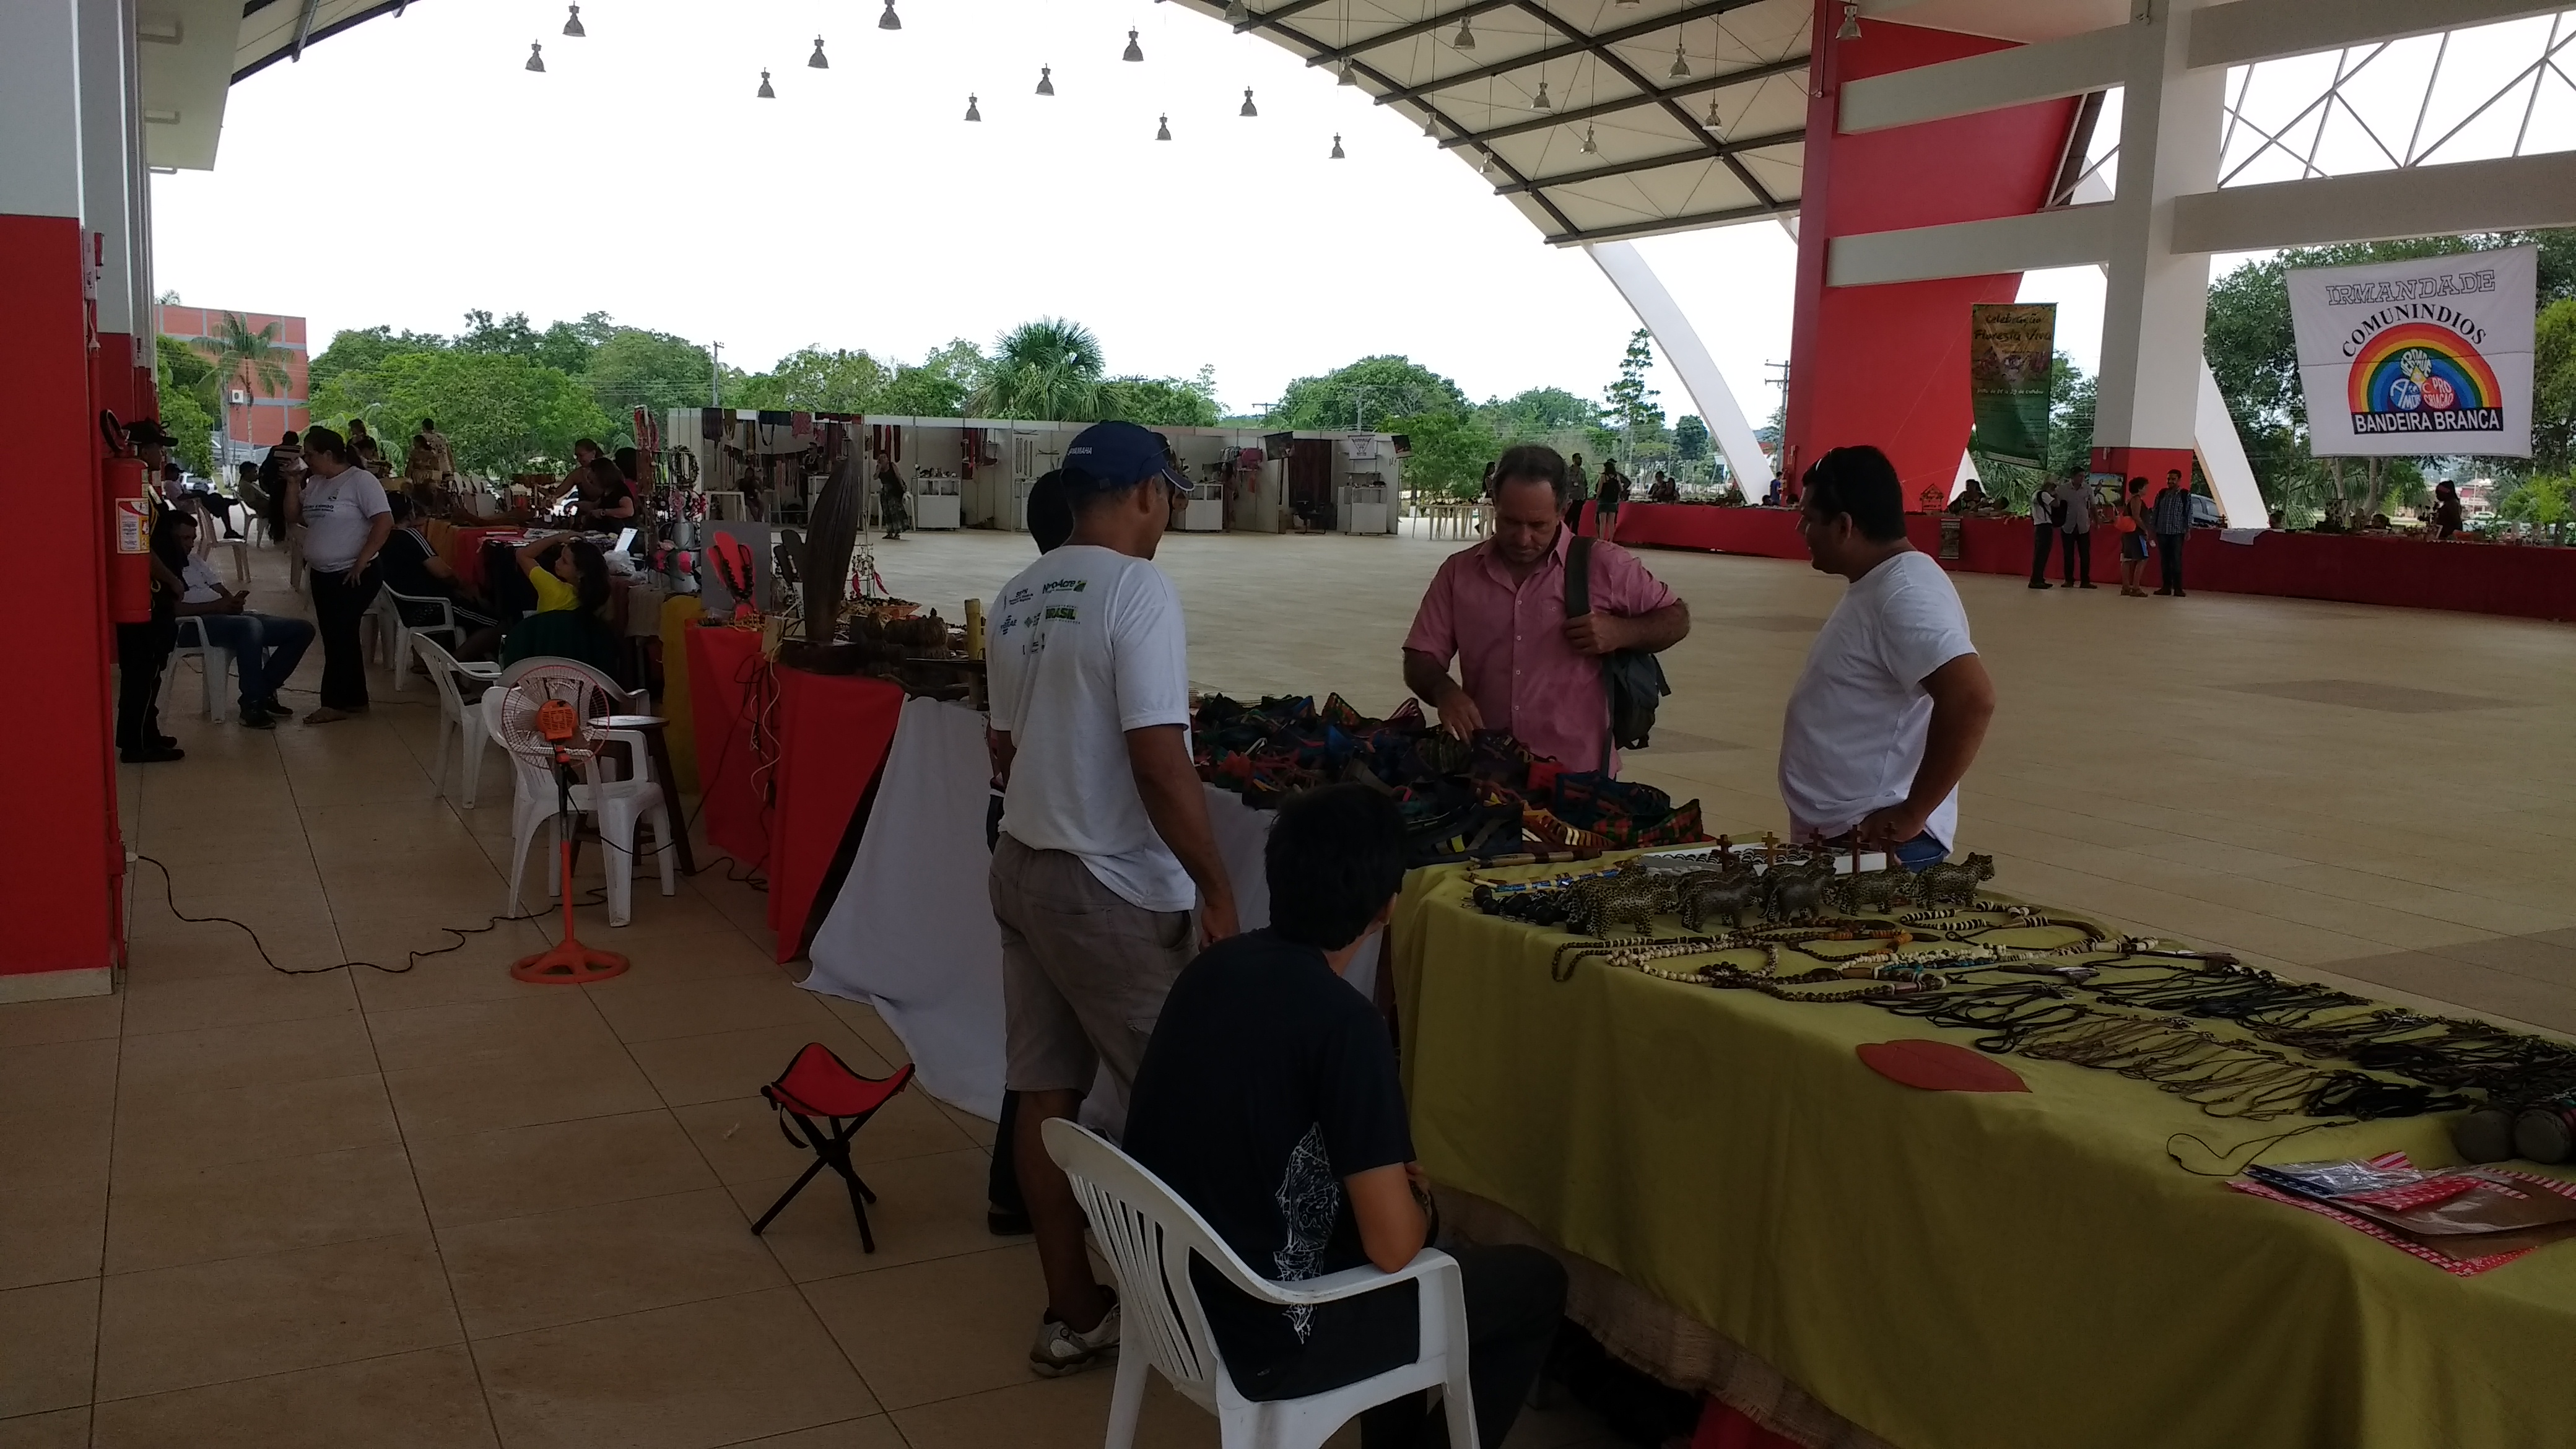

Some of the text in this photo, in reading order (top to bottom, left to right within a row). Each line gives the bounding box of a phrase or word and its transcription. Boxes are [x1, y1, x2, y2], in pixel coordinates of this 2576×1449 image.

[2326, 270, 2495, 305] IRMANDADE
[2343, 303, 2486, 357] COMUNINDIOS
[2401, 349, 2432, 377] VERDADE
[2356, 409, 2500, 432] BANDEIRA BRANCA
